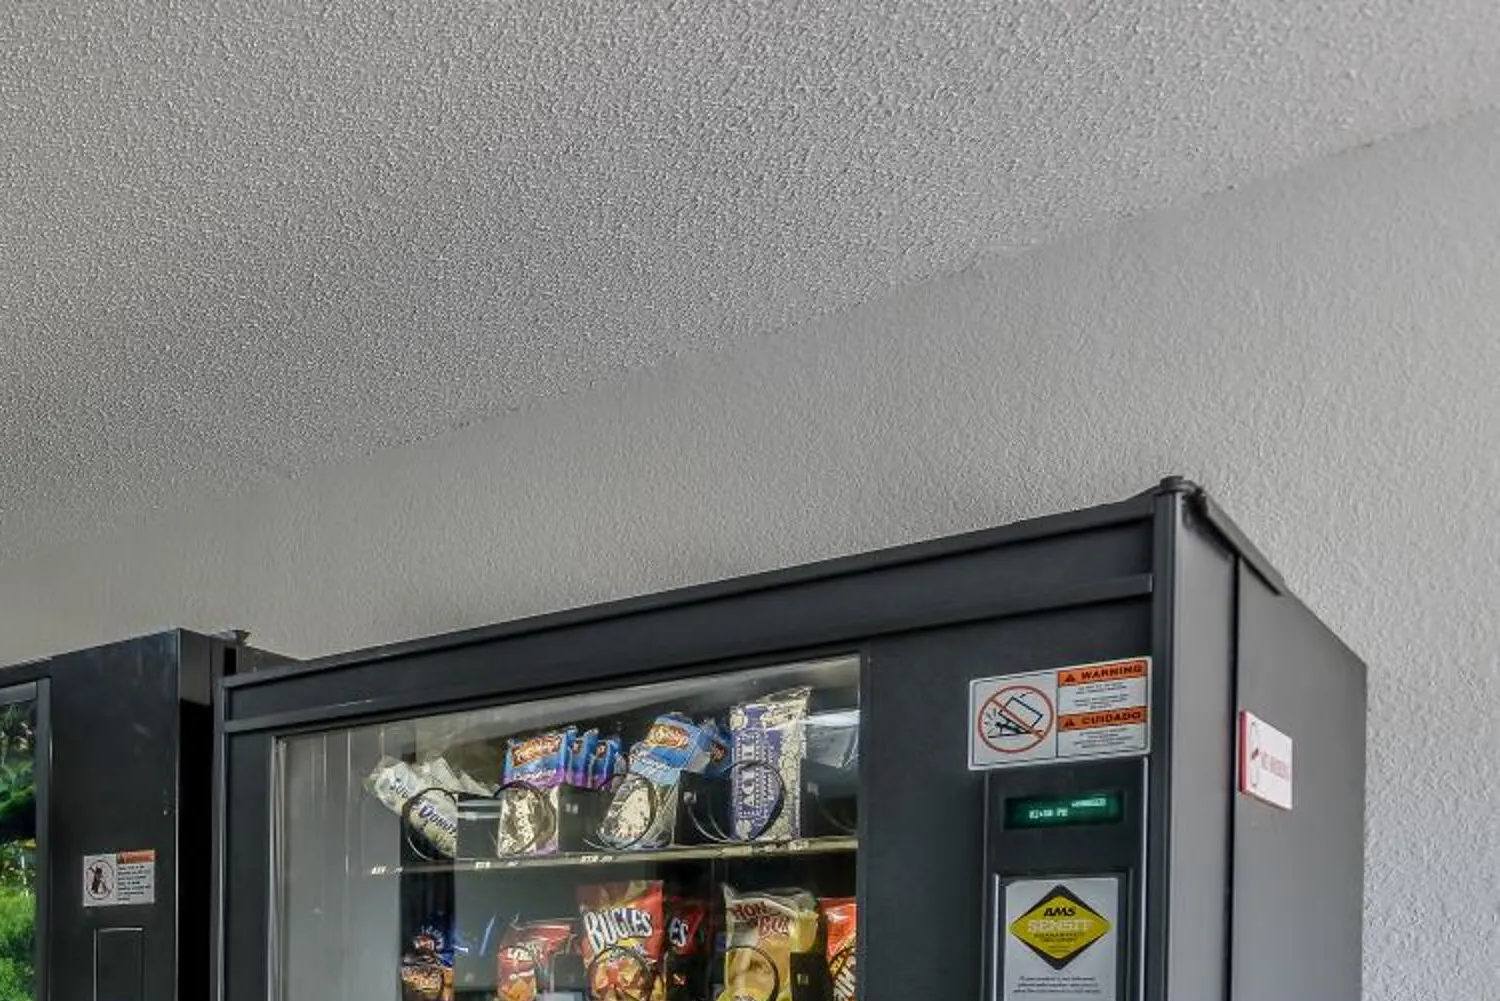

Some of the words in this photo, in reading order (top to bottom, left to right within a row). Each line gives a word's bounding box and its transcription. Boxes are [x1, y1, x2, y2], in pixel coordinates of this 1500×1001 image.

[1081, 664, 1143, 680] WARNING
[1043, 906, 1077, 917] AMS
[584, 907, 653, 954] BUGLES
